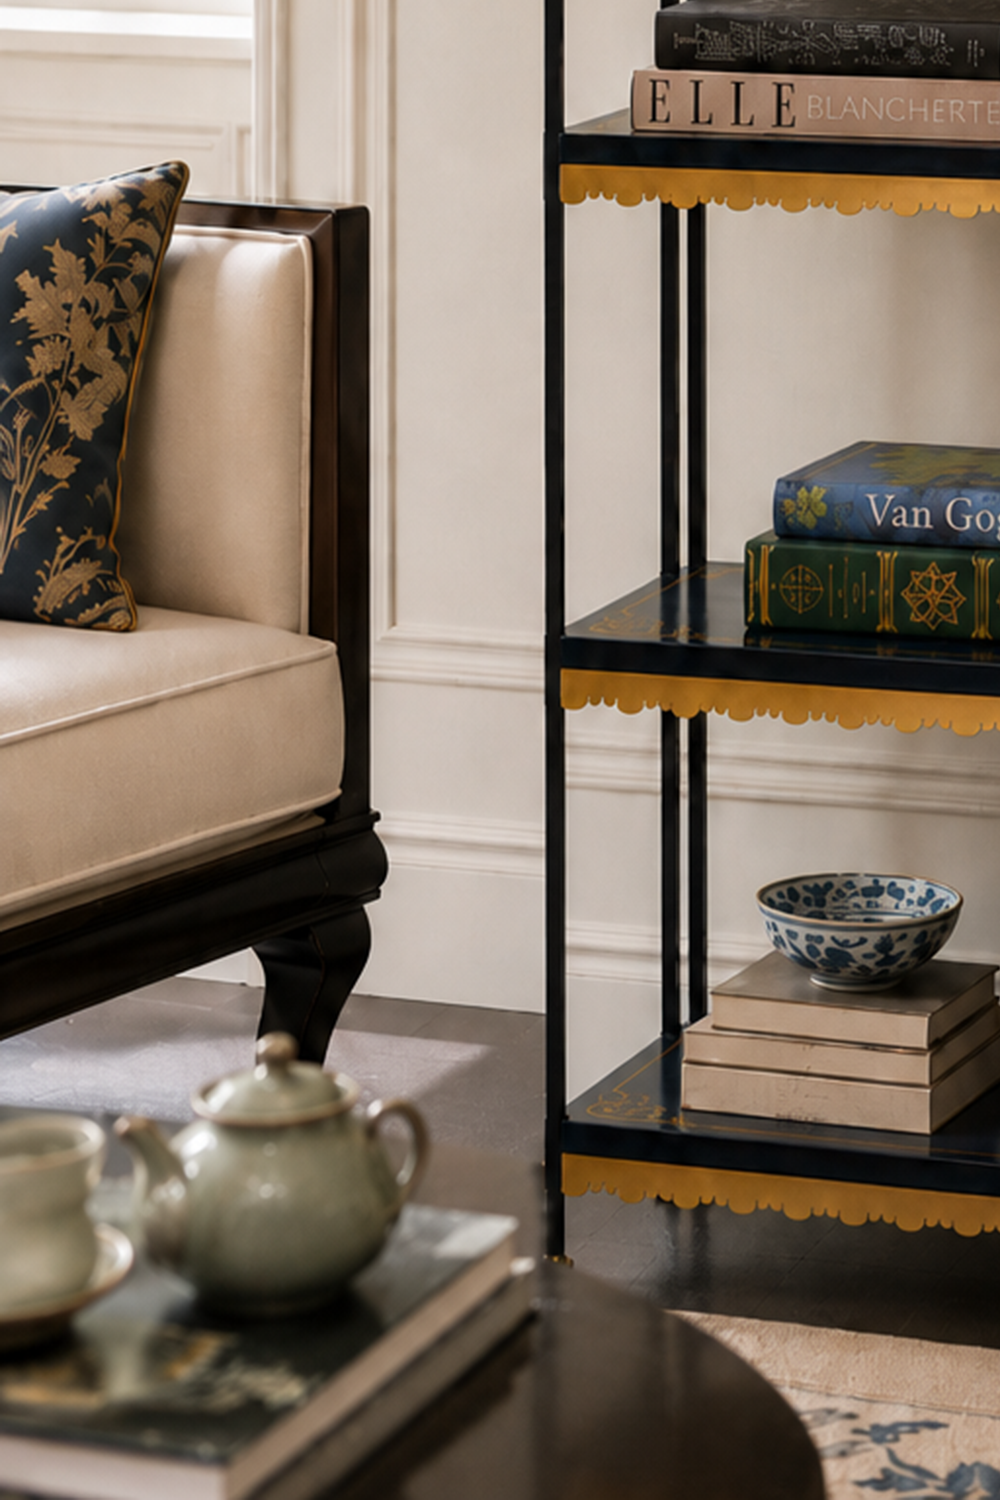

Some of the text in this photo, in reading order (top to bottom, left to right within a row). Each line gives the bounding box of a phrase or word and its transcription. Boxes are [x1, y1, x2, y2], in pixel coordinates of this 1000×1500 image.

[648, 78, 1000, 128] ELLE BLANCHERTE
[864, 493, 933, 530] Van
